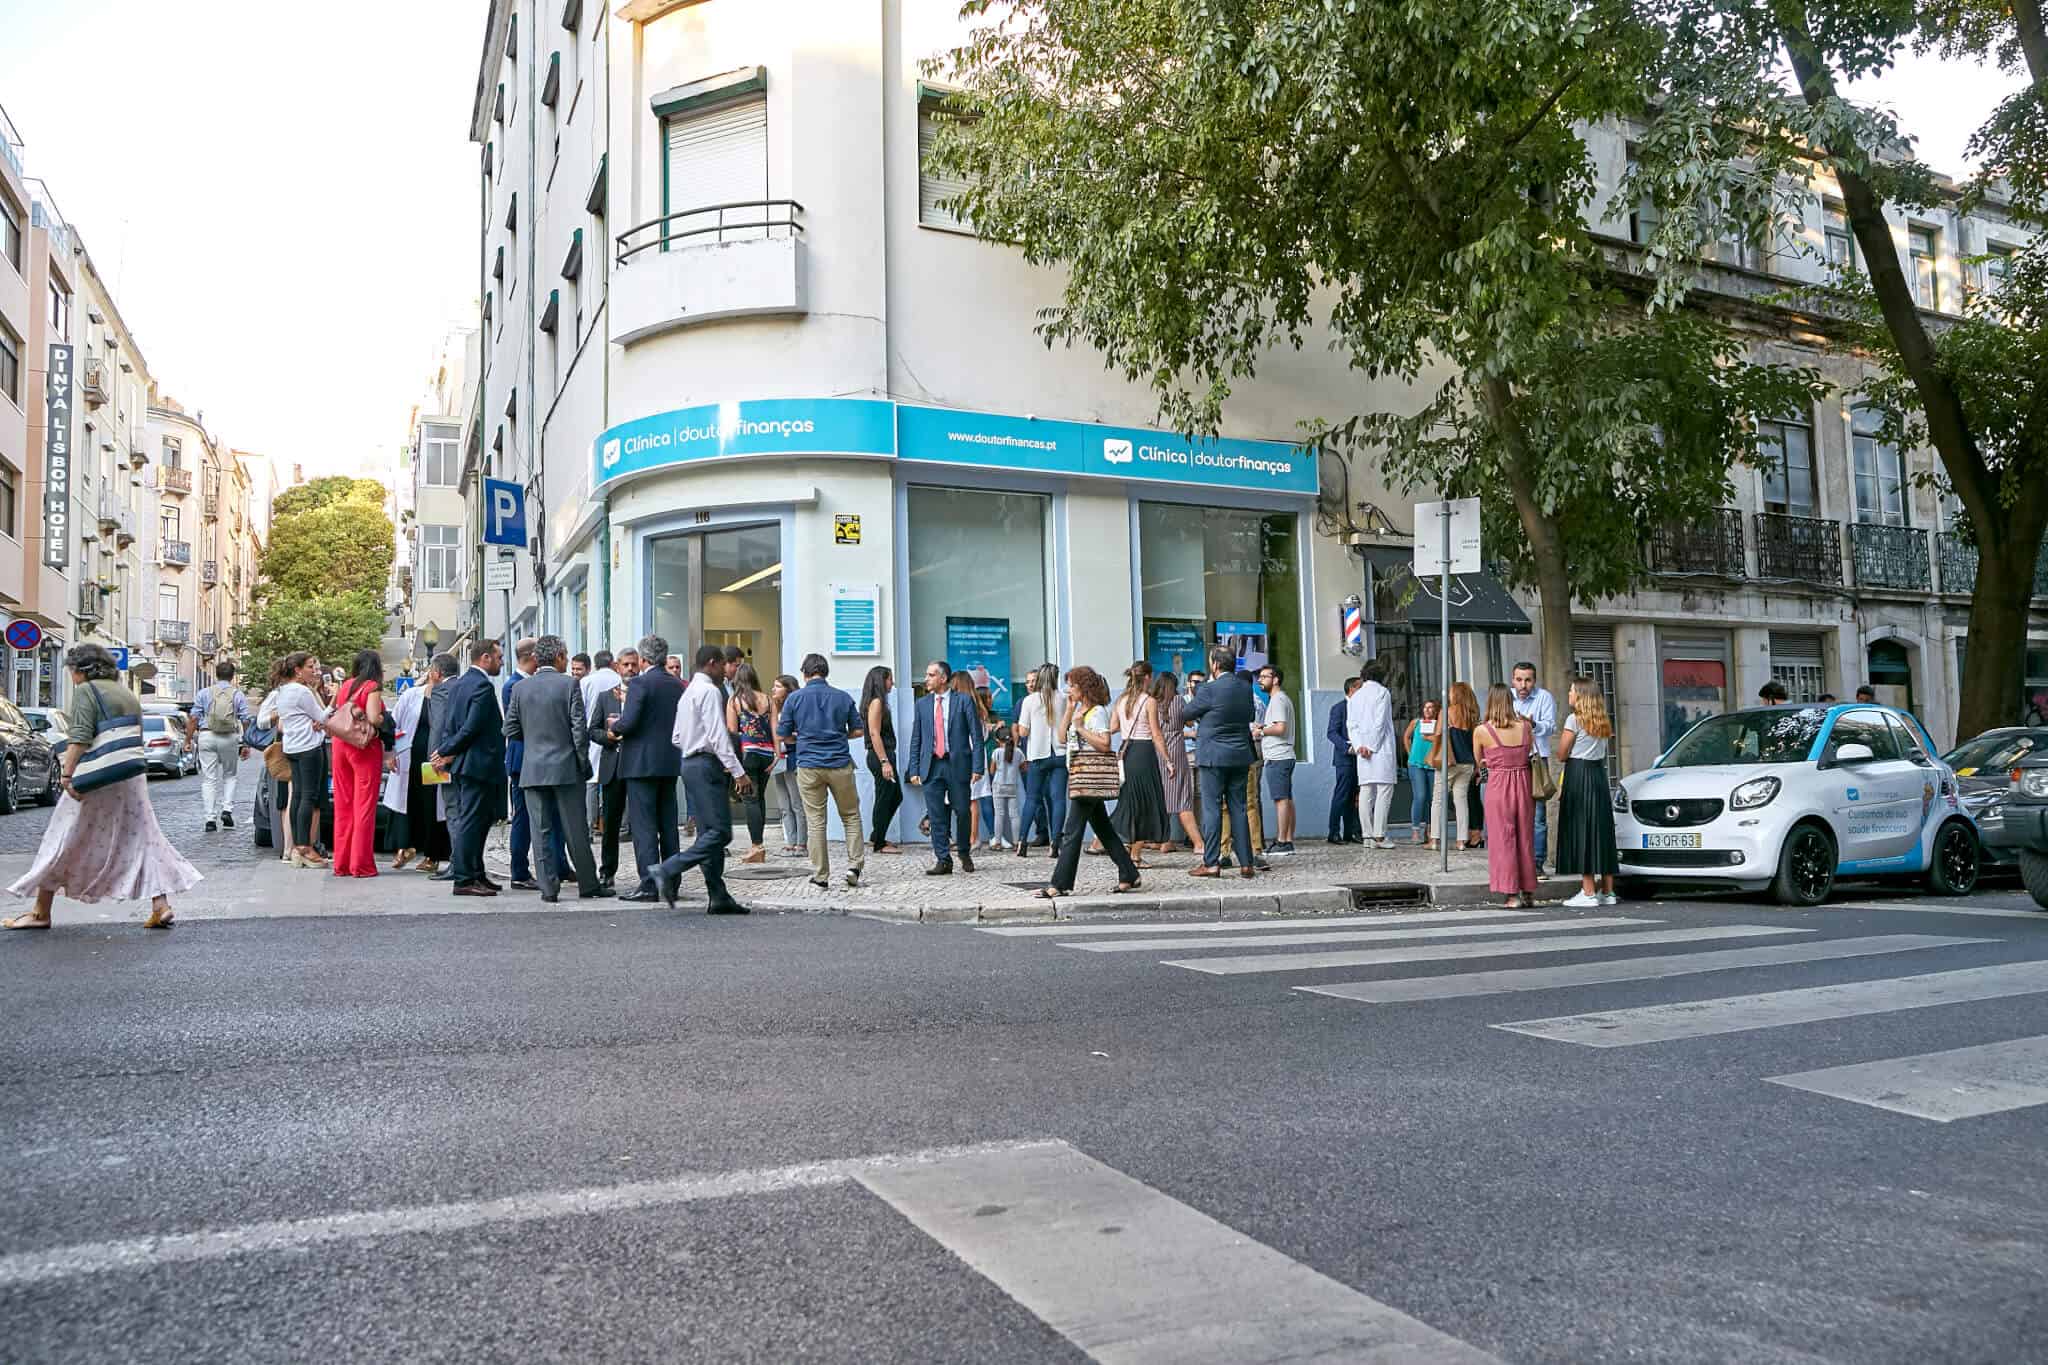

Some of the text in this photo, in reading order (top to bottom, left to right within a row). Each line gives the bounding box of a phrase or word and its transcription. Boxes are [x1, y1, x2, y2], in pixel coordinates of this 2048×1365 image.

[49, 348, 69, 562] DINYA LISBON HOTEL
[624, 432, 671, 454] Clínica
[1138, 445, 1292, 475] Clínica doutorfinanças
[494, 487, 517, 536] P
